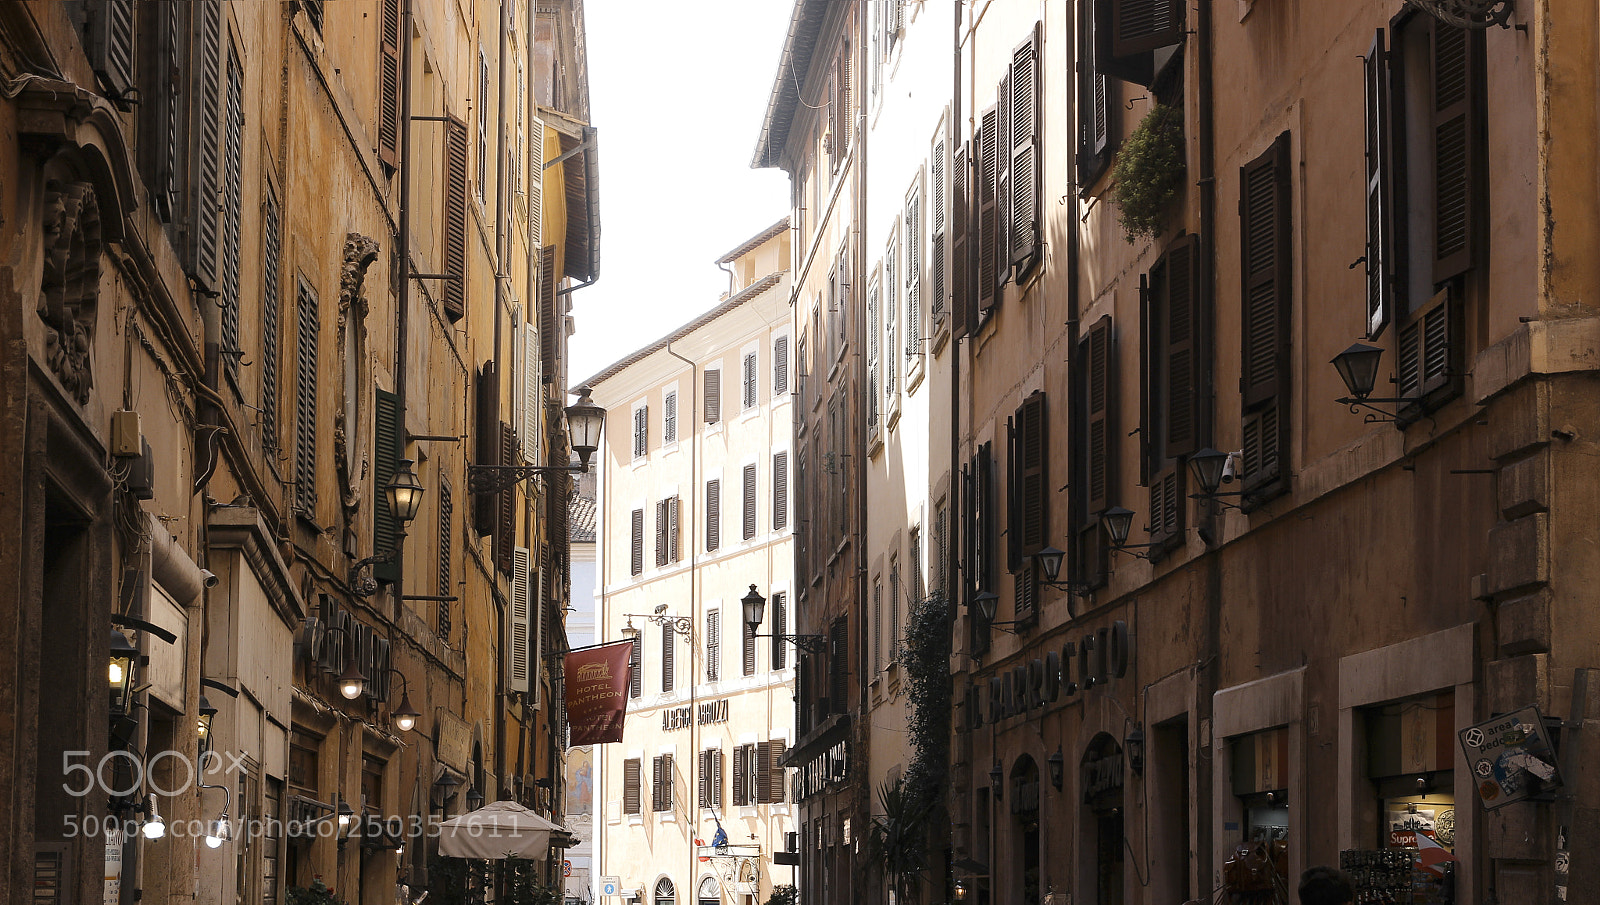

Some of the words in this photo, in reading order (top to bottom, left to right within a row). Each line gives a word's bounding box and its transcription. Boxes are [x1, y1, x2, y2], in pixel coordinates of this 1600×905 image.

[576, 683, 612, 695] HOTEL
[567, 691, 622, 708] PANTHEON
[697, 699, 729, 726] ABRUZZI
[572, 722, 622, 732] PANTHEON
[1487, 721, 1512, 736] area
[1479, 737, 1505, 754] pedo
